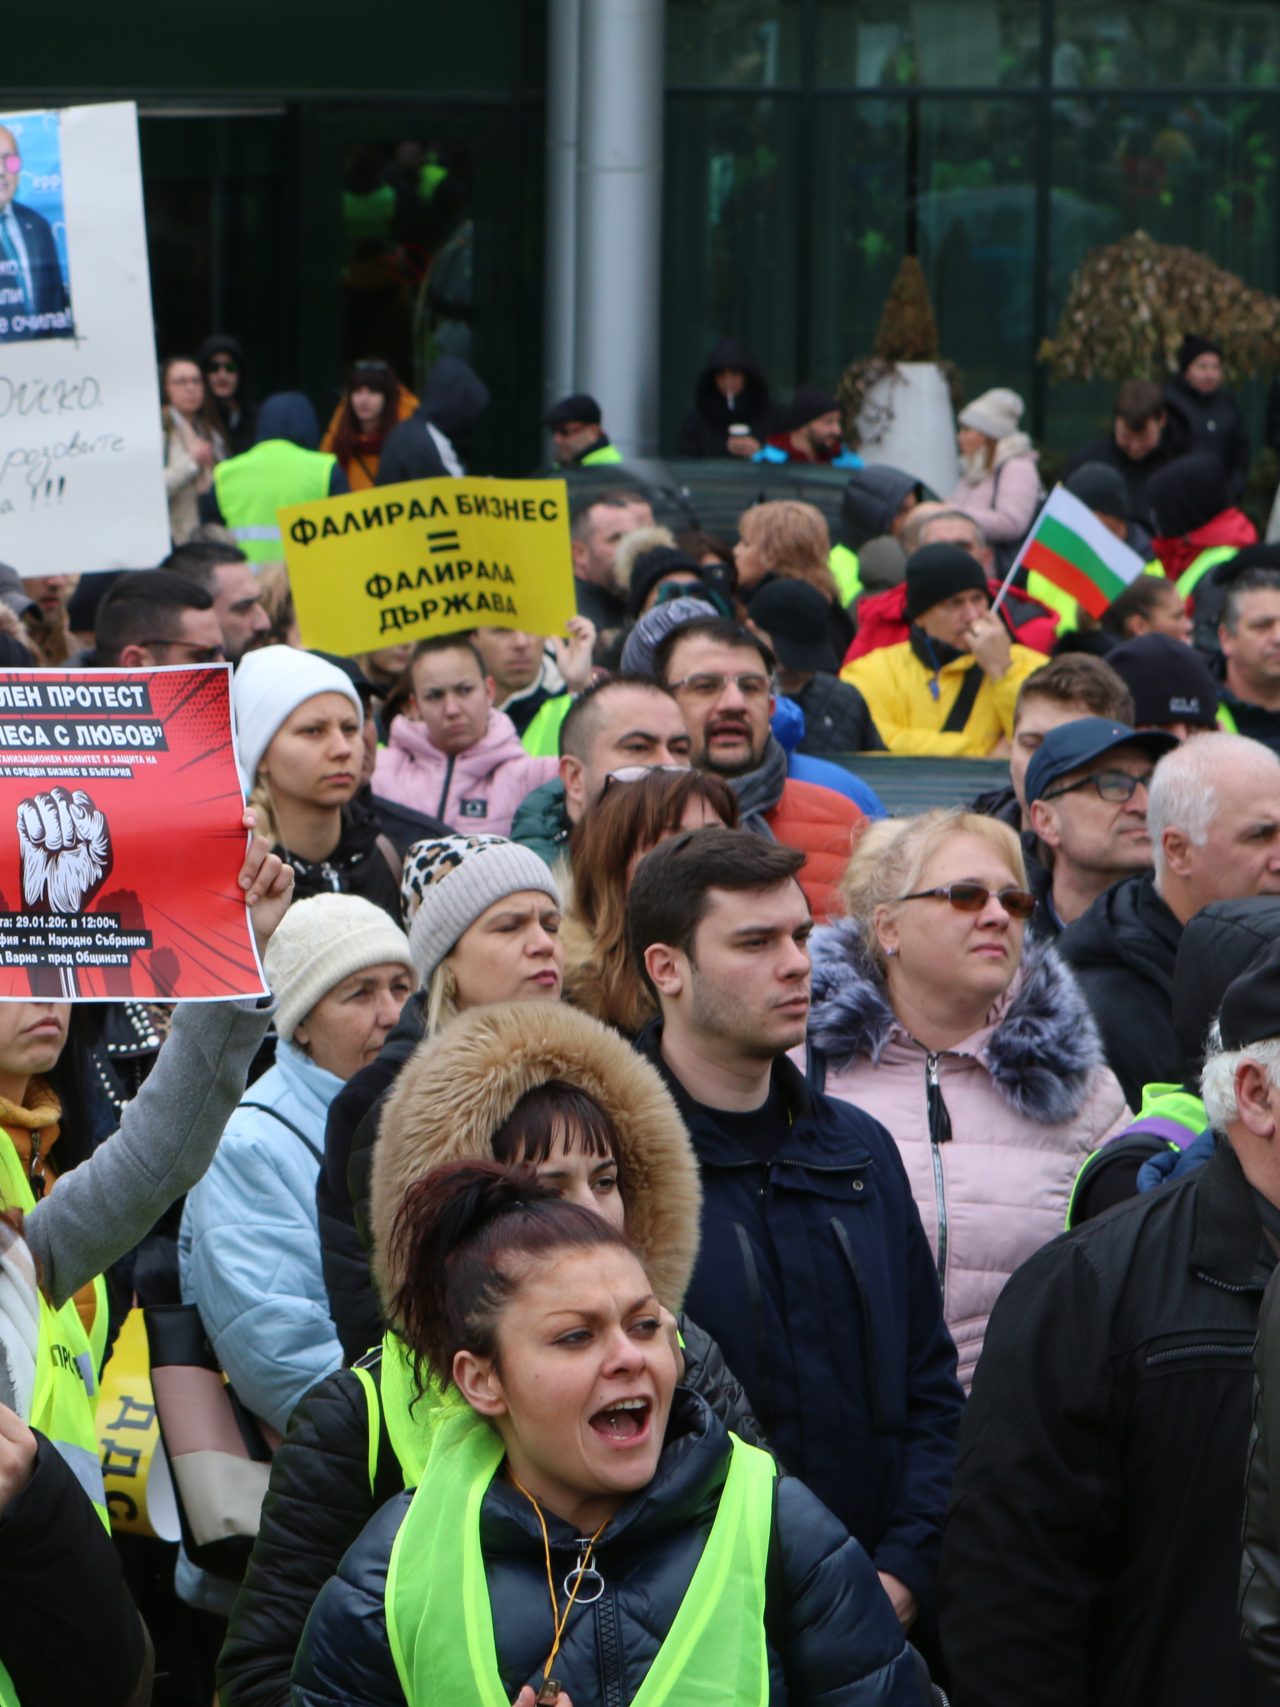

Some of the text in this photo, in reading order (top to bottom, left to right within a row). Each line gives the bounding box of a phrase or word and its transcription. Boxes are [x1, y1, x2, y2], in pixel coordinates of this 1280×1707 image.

[290, 493, 559, 546] ФАЛИРАЛ БИЗНЕС
[365, 559, 516, 600] ФАЛИРАЛА
[379, 591, 518, 635] ДЪРЖАВА
[46, 686, 144, 708] ПРОТЕСТ
[53, 725, 70, 746] С
[63, 755, 102, 764] КОМИТЕТ
[111, 755, 145, 766] ЗАЩИТА
[146, 755, 158, 764] НА
[12, 767, 47, 778] СРЕДЕН
[47, 768, 80, 777] БИЗНЕС
[89, 768, 132, 777] БЪЛГАРИЯ
[15, 916, 68, 929] 29.01.20г.
[71, 919, 78, 928] в
[81, 916, 118, 929] 12:00ч.
[29, 935, 45, 946] пл.
[48, 933, 93, 948] Народно
[95, 933, 146, 948] Събрание
[5, 950, 38, 966] Варна
[47, 953, 74, 966] пред
[75, 951, 129, 965] Общината
